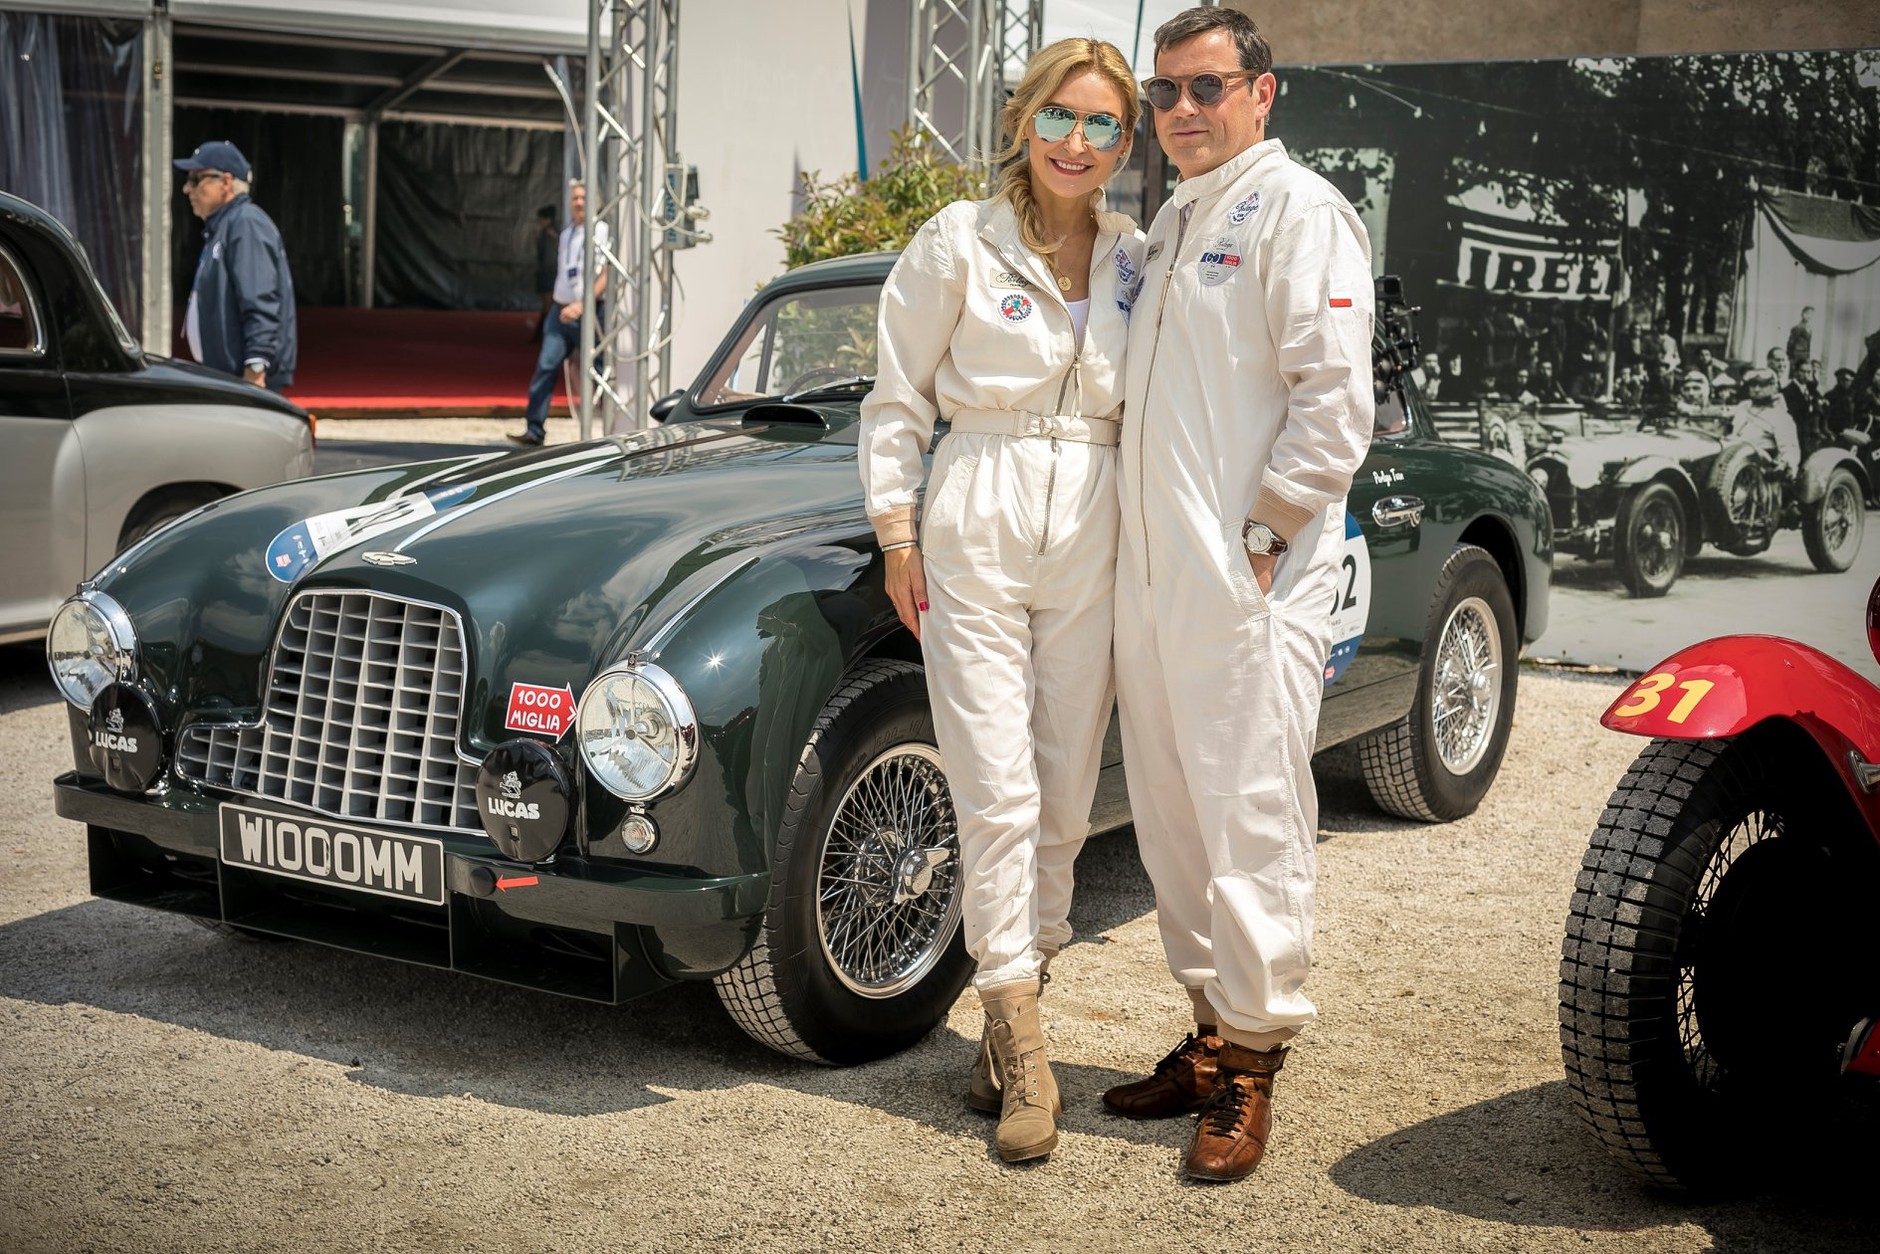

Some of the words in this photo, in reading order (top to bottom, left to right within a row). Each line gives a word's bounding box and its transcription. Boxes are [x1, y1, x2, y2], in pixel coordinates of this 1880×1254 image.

[517, 689, 562, 709] 1000
[1613, 672, 1716, 725] 31
[509, 709, 561, 731] MIGLIA
[95, 730, 139, 754] LUCAS
[487, 796, 541, 820] LUCAS
